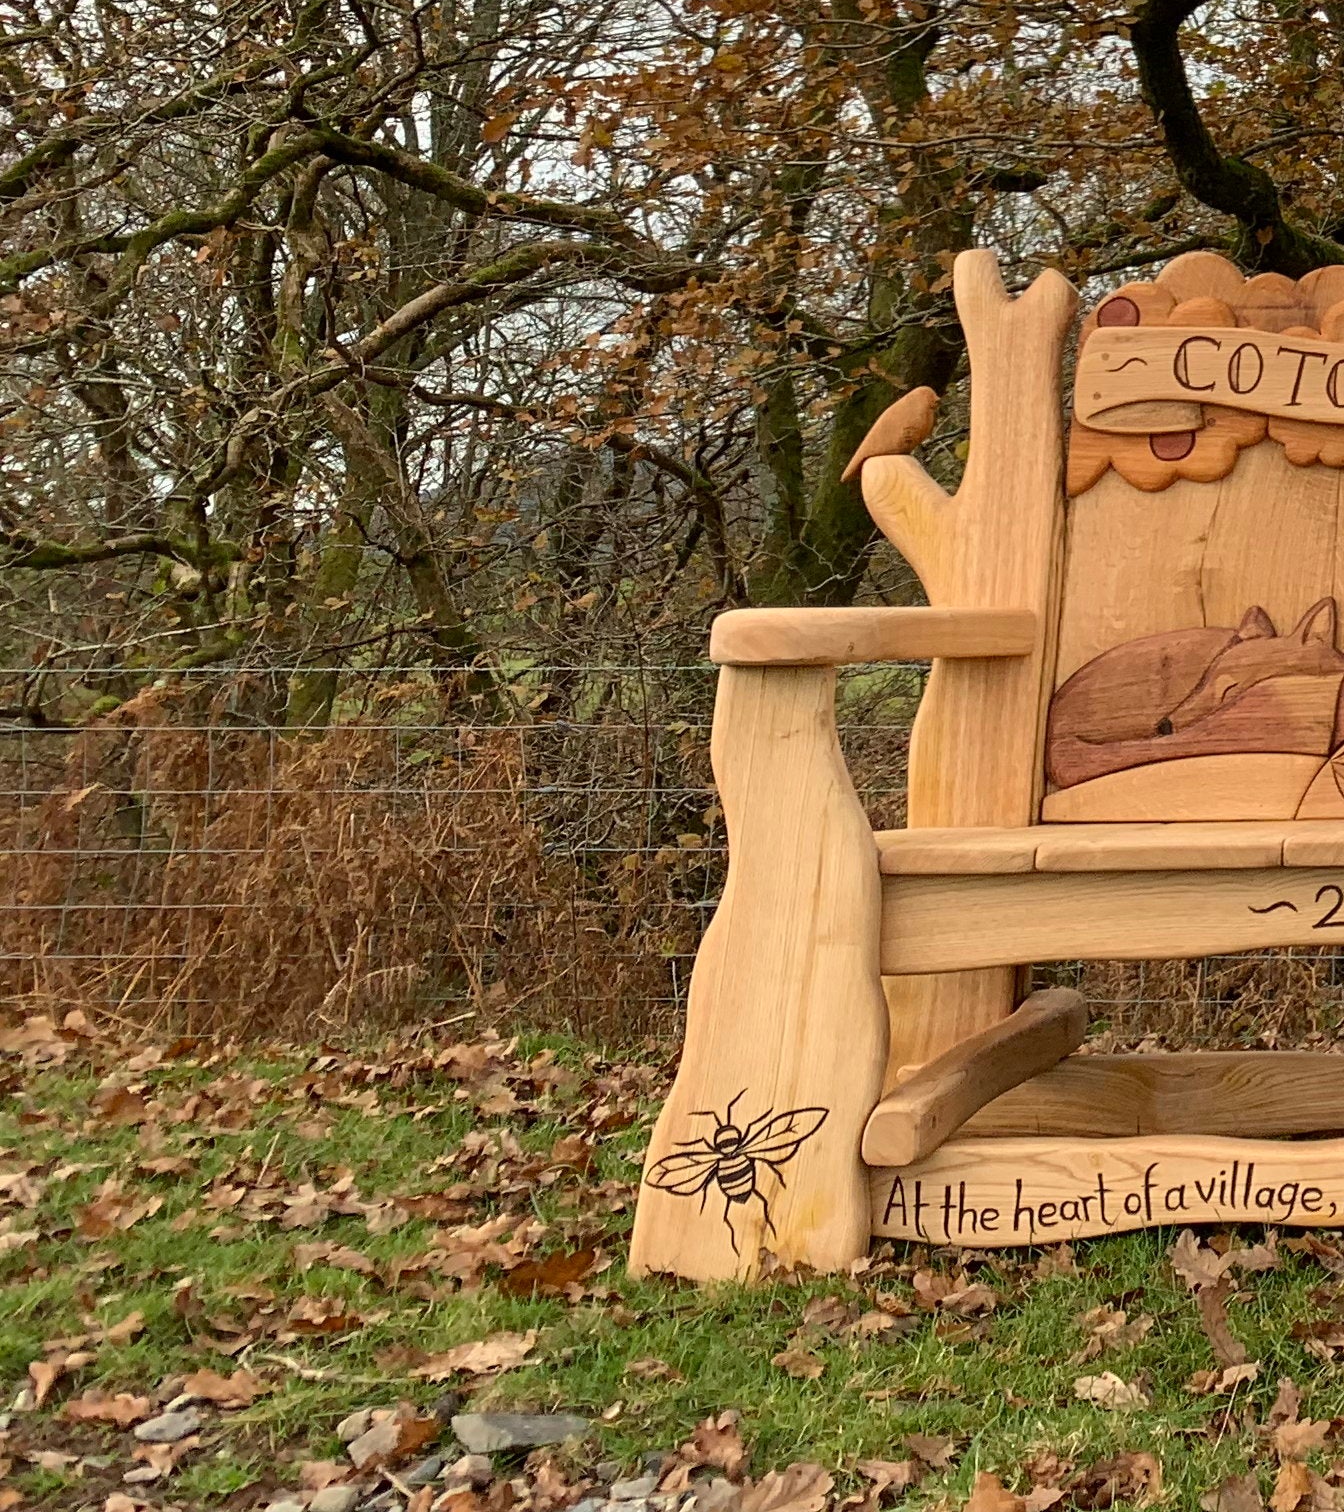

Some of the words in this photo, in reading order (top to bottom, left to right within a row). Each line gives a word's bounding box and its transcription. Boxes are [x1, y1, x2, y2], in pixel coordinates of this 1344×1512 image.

[882, 1175, 926, 1239] At
[940, 1181, 1001, 1240] the
[1013, 1172, 1116, 1233] heart
[1123, 1162, 1160, 1222] of
[1164, 1184, 1188, 1212] a
[1194, 1159, 1338, 1222] village,
